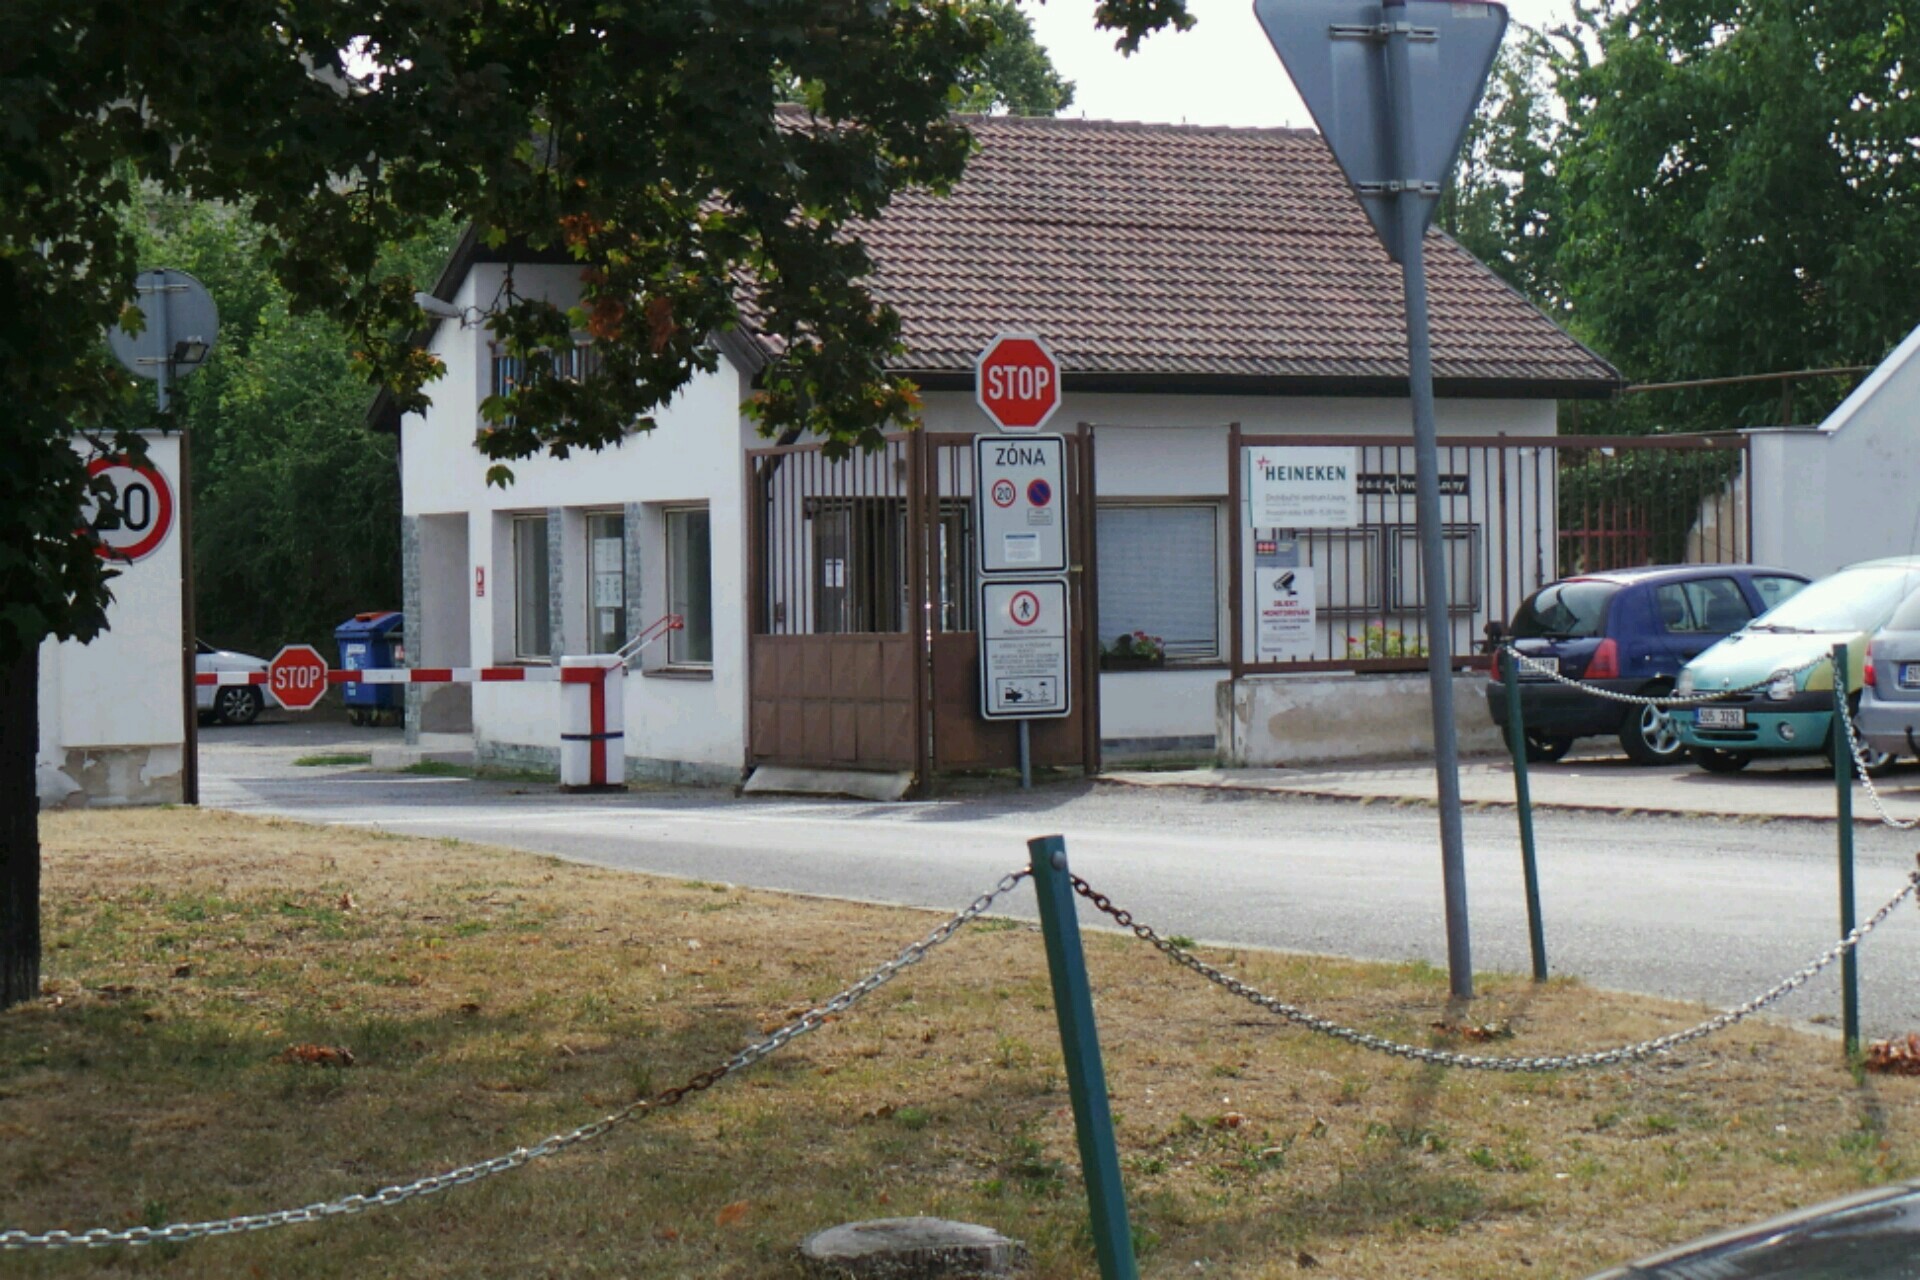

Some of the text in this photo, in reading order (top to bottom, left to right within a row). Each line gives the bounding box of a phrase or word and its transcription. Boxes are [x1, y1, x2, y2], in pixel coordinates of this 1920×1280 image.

[988, 365, 1050, 400] STOP
[995, 443, 1046, 466] ZÓNA
[1265, 466, 1346, 481] HEINEKEN
[996, 487, 1012, 501] 20
[275, 665, 320, 690] STOP
